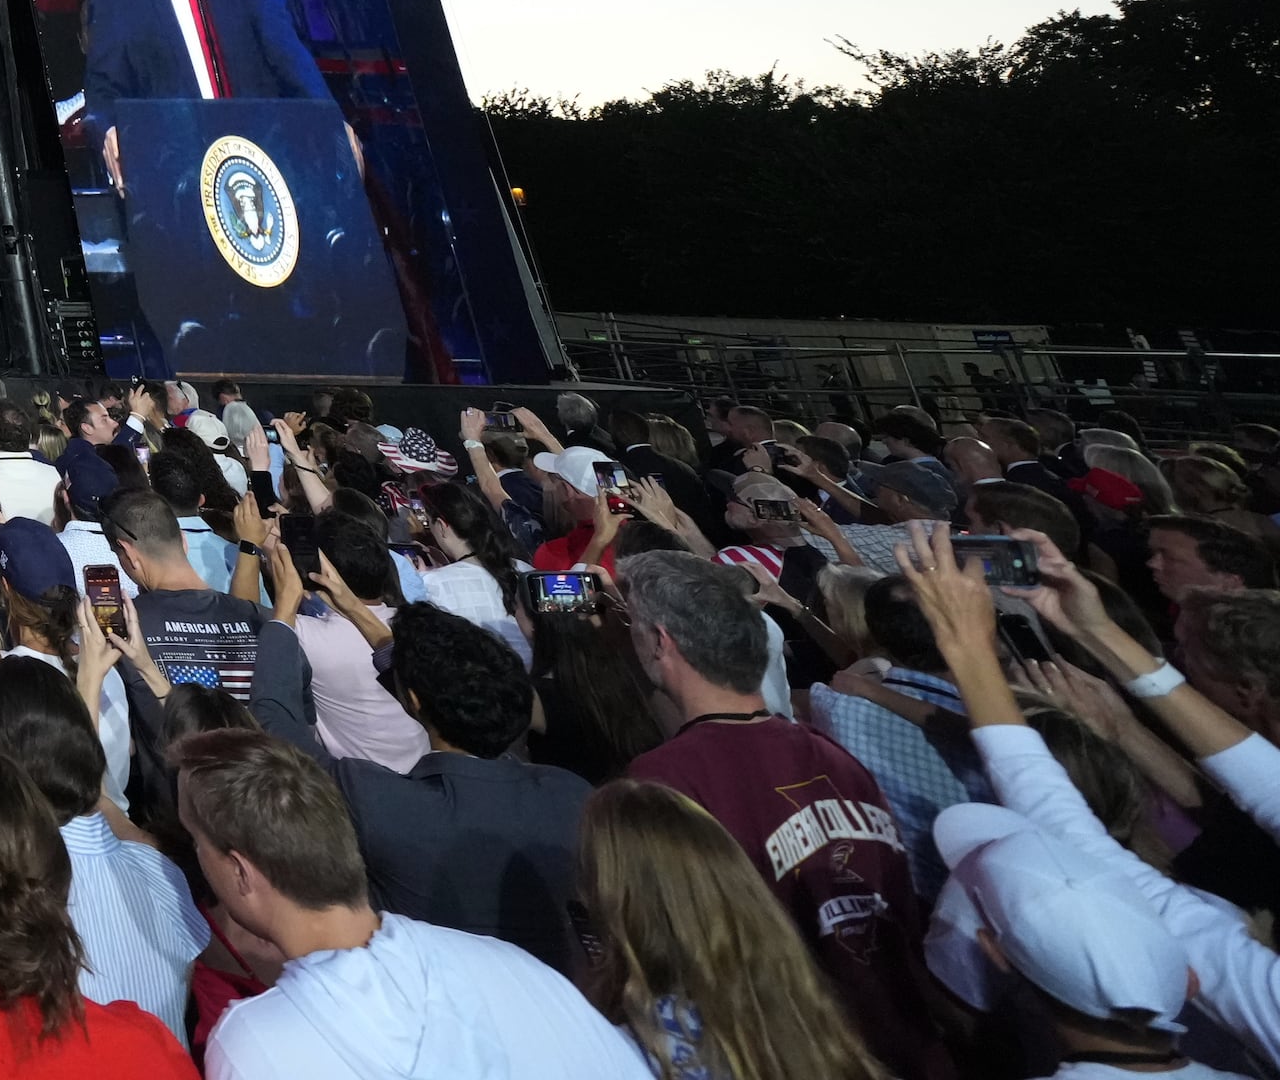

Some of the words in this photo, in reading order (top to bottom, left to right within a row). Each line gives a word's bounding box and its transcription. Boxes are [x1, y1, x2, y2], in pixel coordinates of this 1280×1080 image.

[204, 142, 230, 208] PRESIDENT
[164, 621, 221, 634] AMERICAN
[222, 621, 251, 634] FLAG
[765, 805, 829, 882] EUREKA
